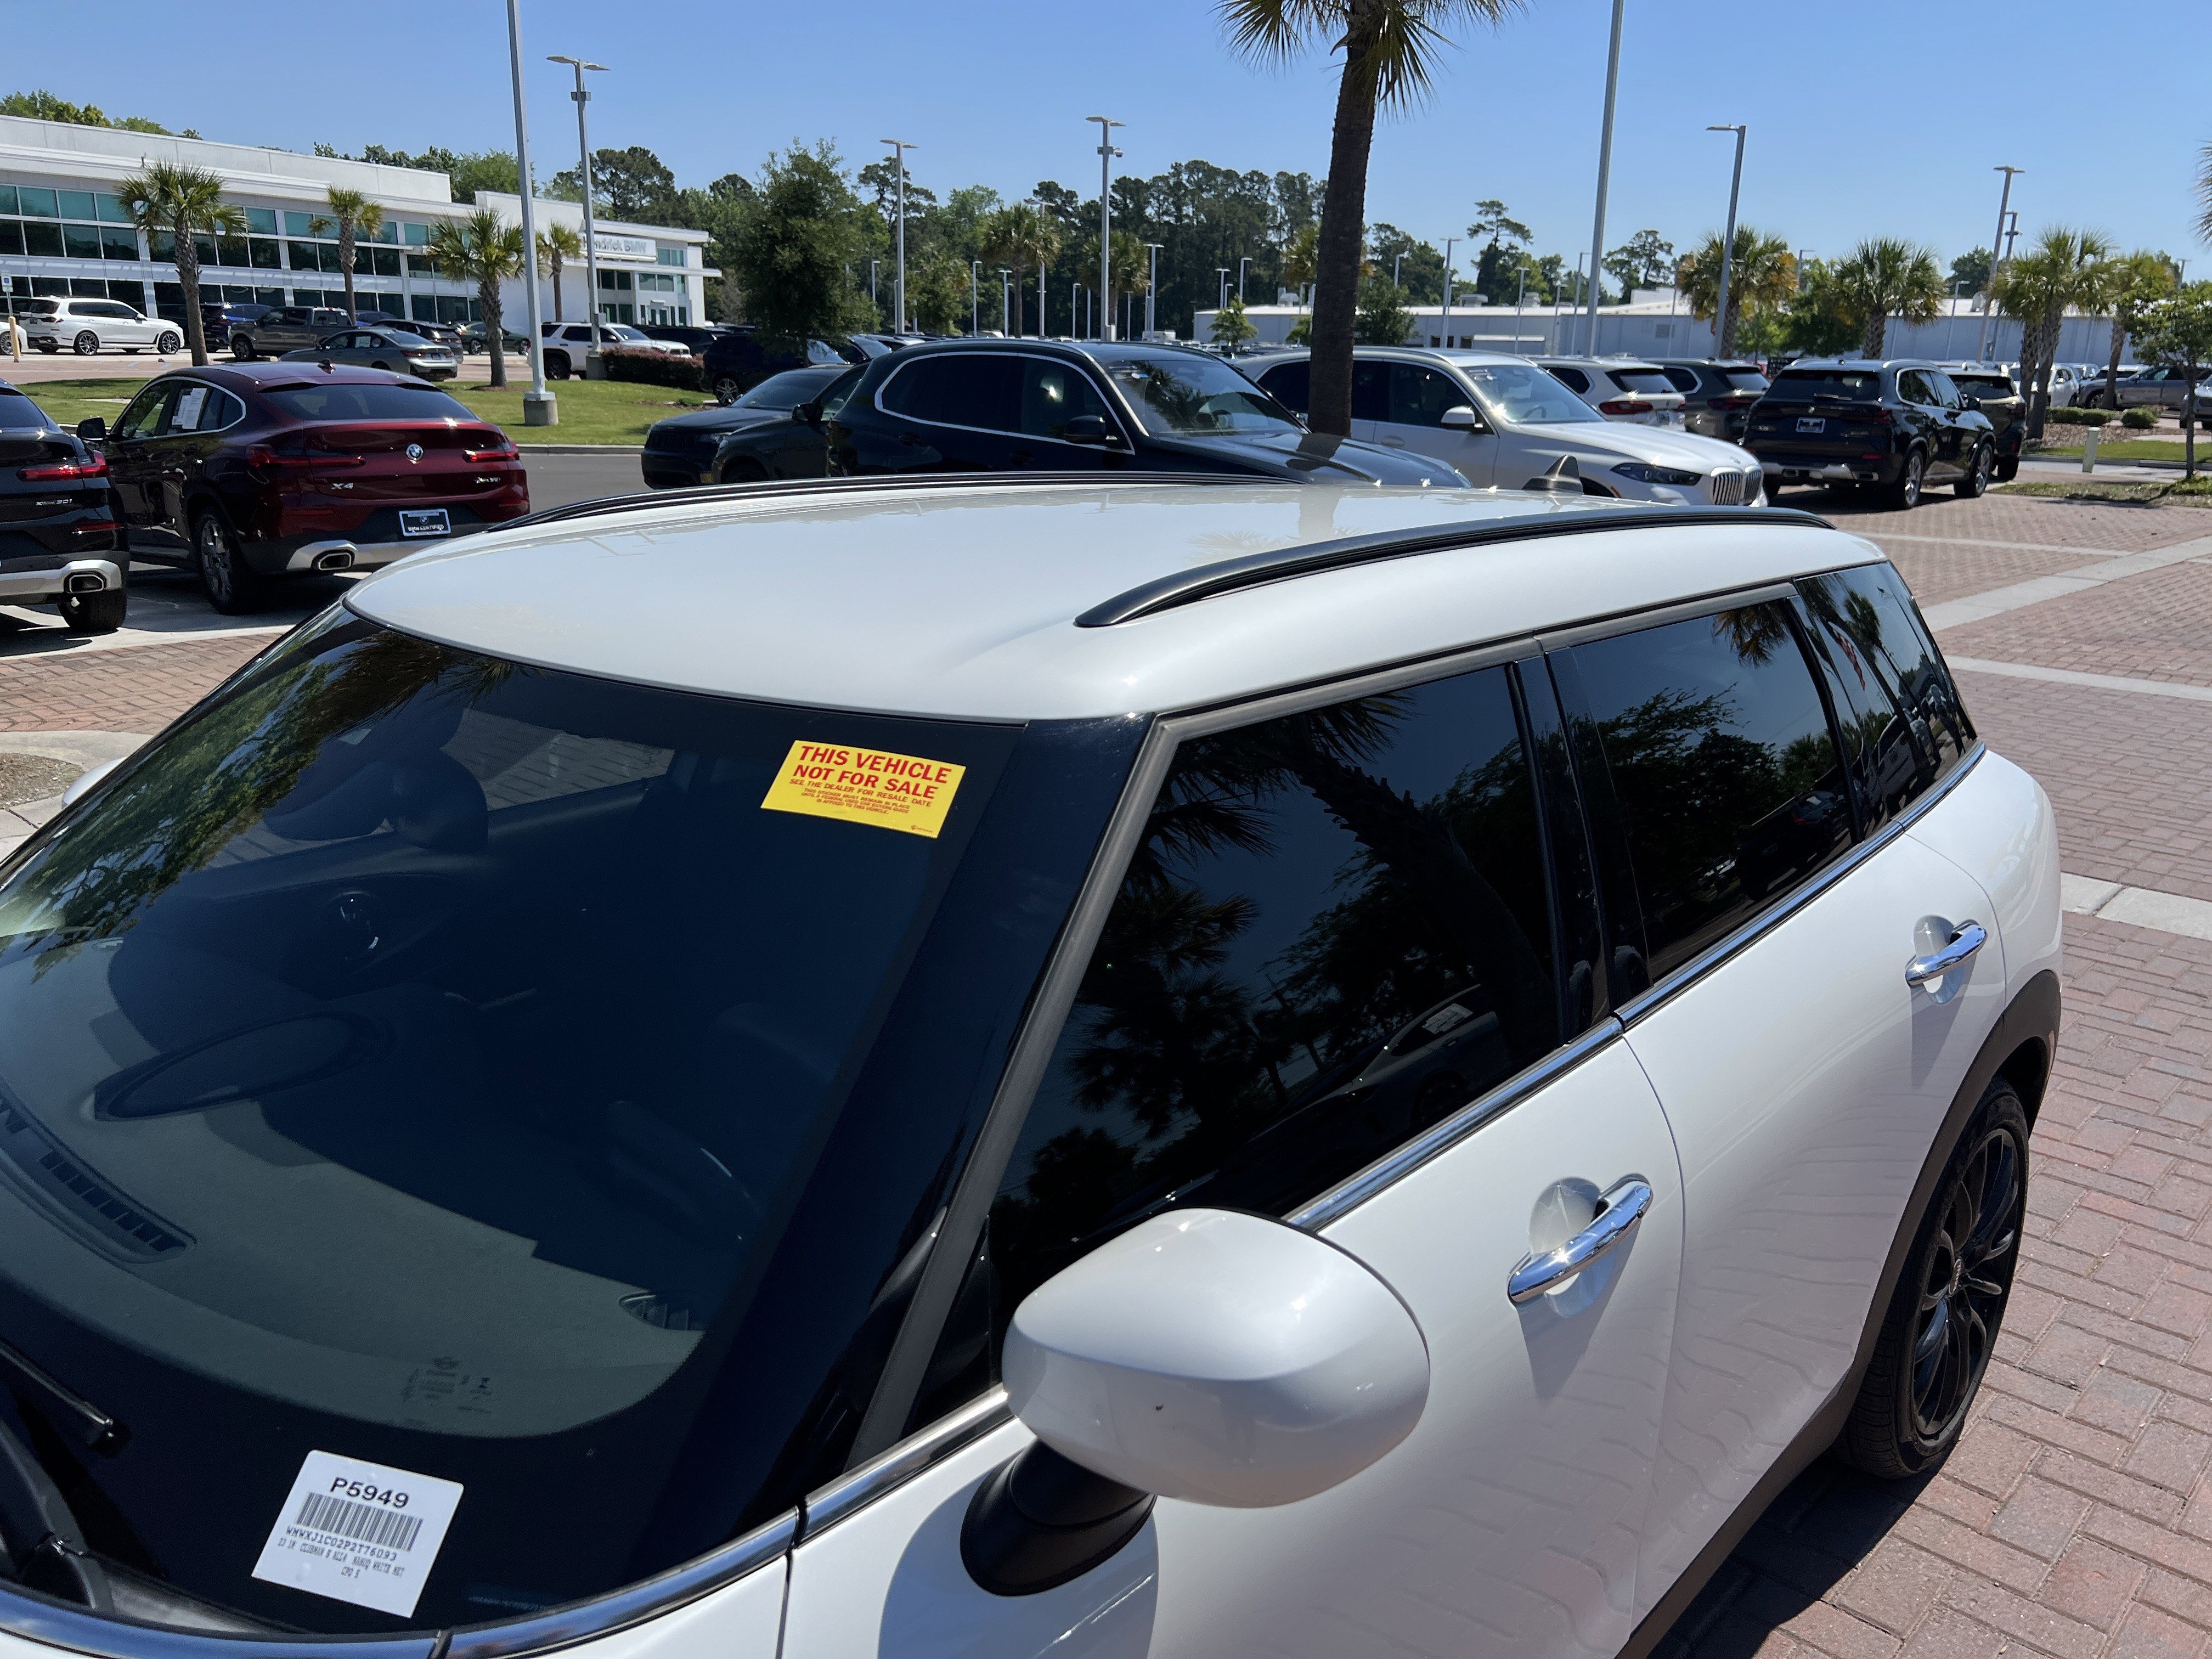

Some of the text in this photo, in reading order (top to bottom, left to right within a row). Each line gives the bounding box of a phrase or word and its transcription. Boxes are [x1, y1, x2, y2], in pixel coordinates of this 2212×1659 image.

[799, 745, 952, 783] THIS VEHICLE
[793, 764, 939, 799] NOT FOR SALE
[824, 783, 855, 793] DEALER
[857, 788, 874, 796] FOR
[877, 791, 909, 802] RESALE
[911, 798, 933, 808] DATE
[330, 1477, 409, 1509] P5949
